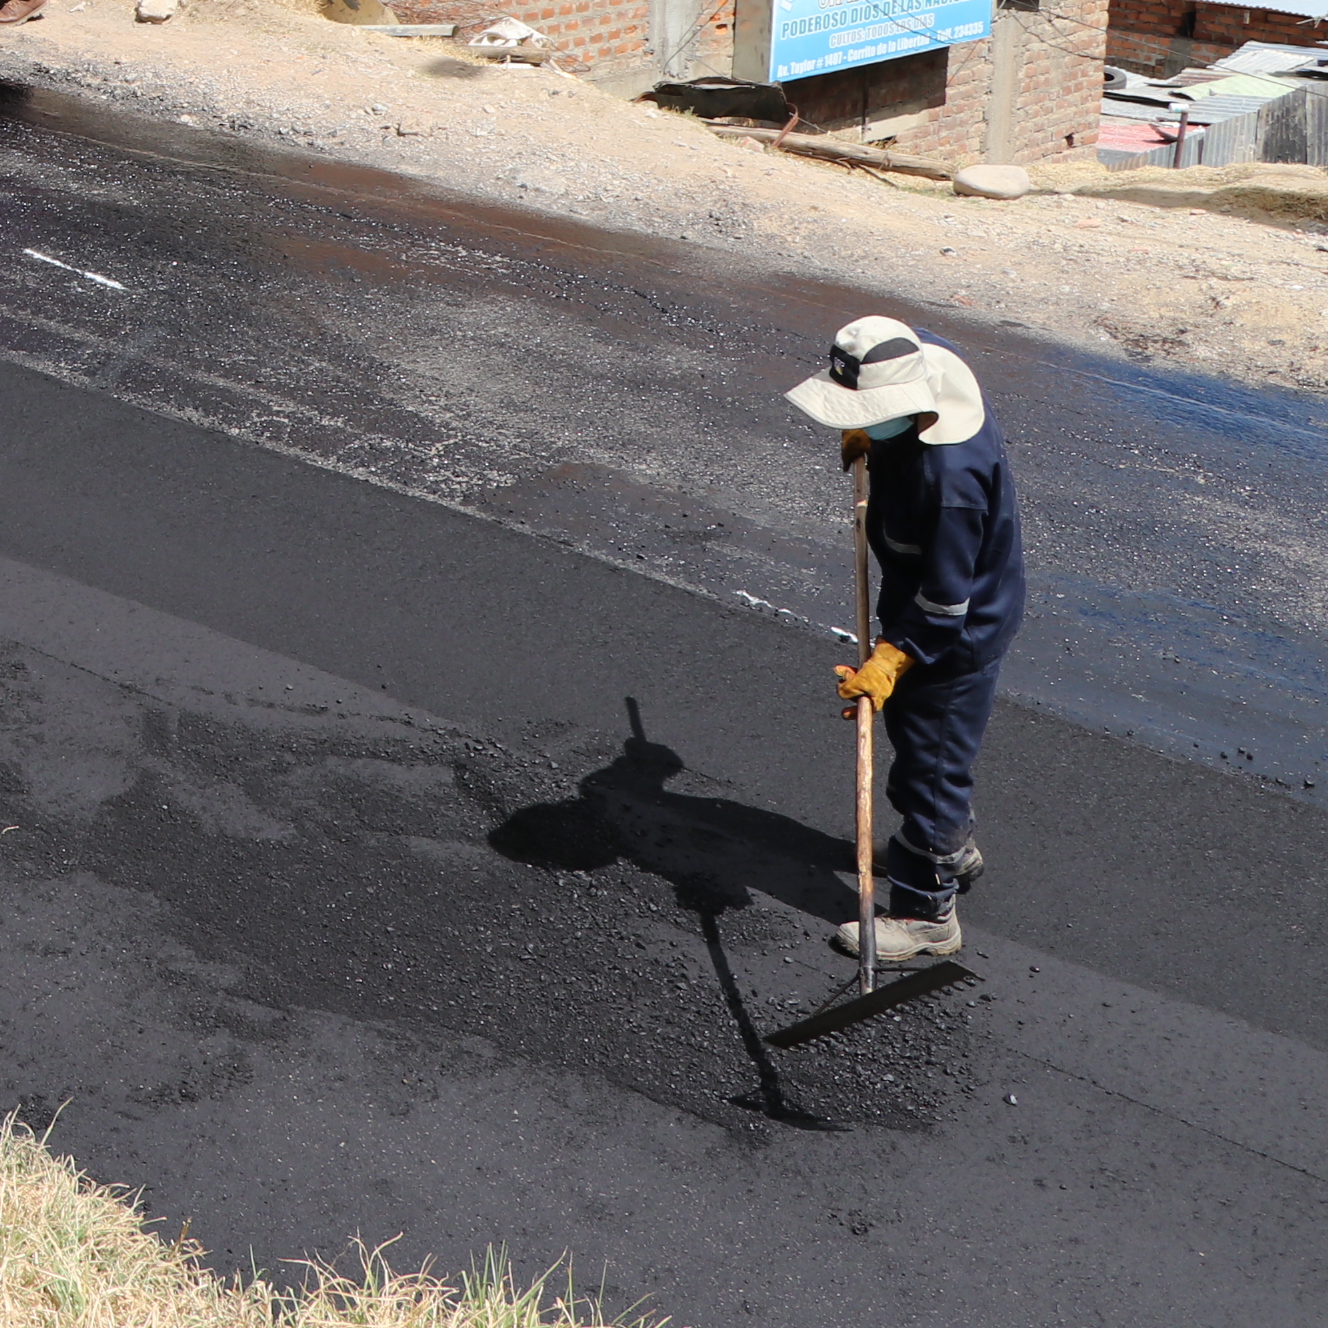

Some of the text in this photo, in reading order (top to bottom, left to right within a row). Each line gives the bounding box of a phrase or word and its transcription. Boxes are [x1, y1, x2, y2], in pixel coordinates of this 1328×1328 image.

[781, 11, 848, 38] PODEROSO
[850, 3, 880, 24] DIOS
[883, 0, 899, 17] DE
[831, 28, 865, 47] CULTOS:
[866, 21, 895, 39] TODOS
[896, 18, 912, 32] LOS
[777, 64, 790, 78] Av.
[790, 59, 816, 74] Taylor
[824, 51, 843, 67] 1407
[876, 42, 887, 56] de
[888, 40, 896, 53] la
[897, 32, 931, 52] Libertad
[953, 21, 984, 39] 234335
